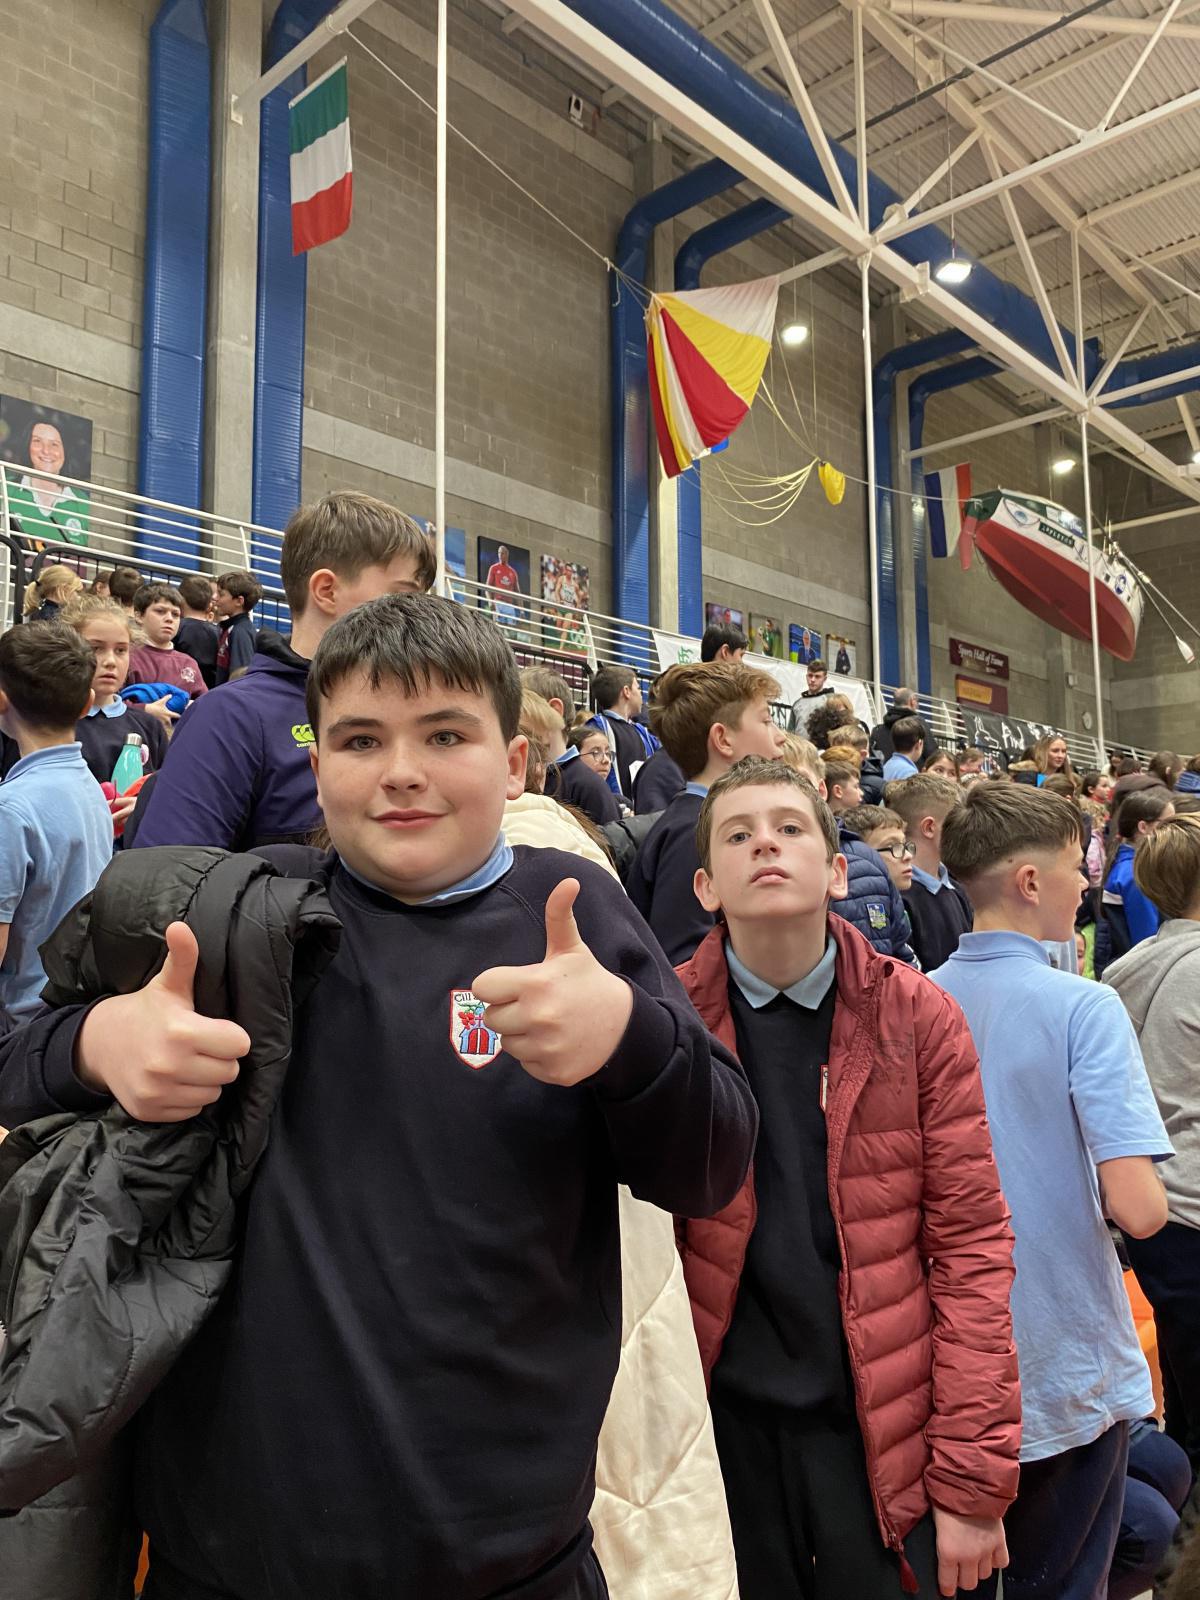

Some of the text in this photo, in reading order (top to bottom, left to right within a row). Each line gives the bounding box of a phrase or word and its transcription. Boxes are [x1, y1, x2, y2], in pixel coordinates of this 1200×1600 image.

[973, 648, 985, 661] Hall
[985, 652, 991, 666] of
[991, 654, 1004, 667] Fame
[454, 992, 472, 1002] Cill
